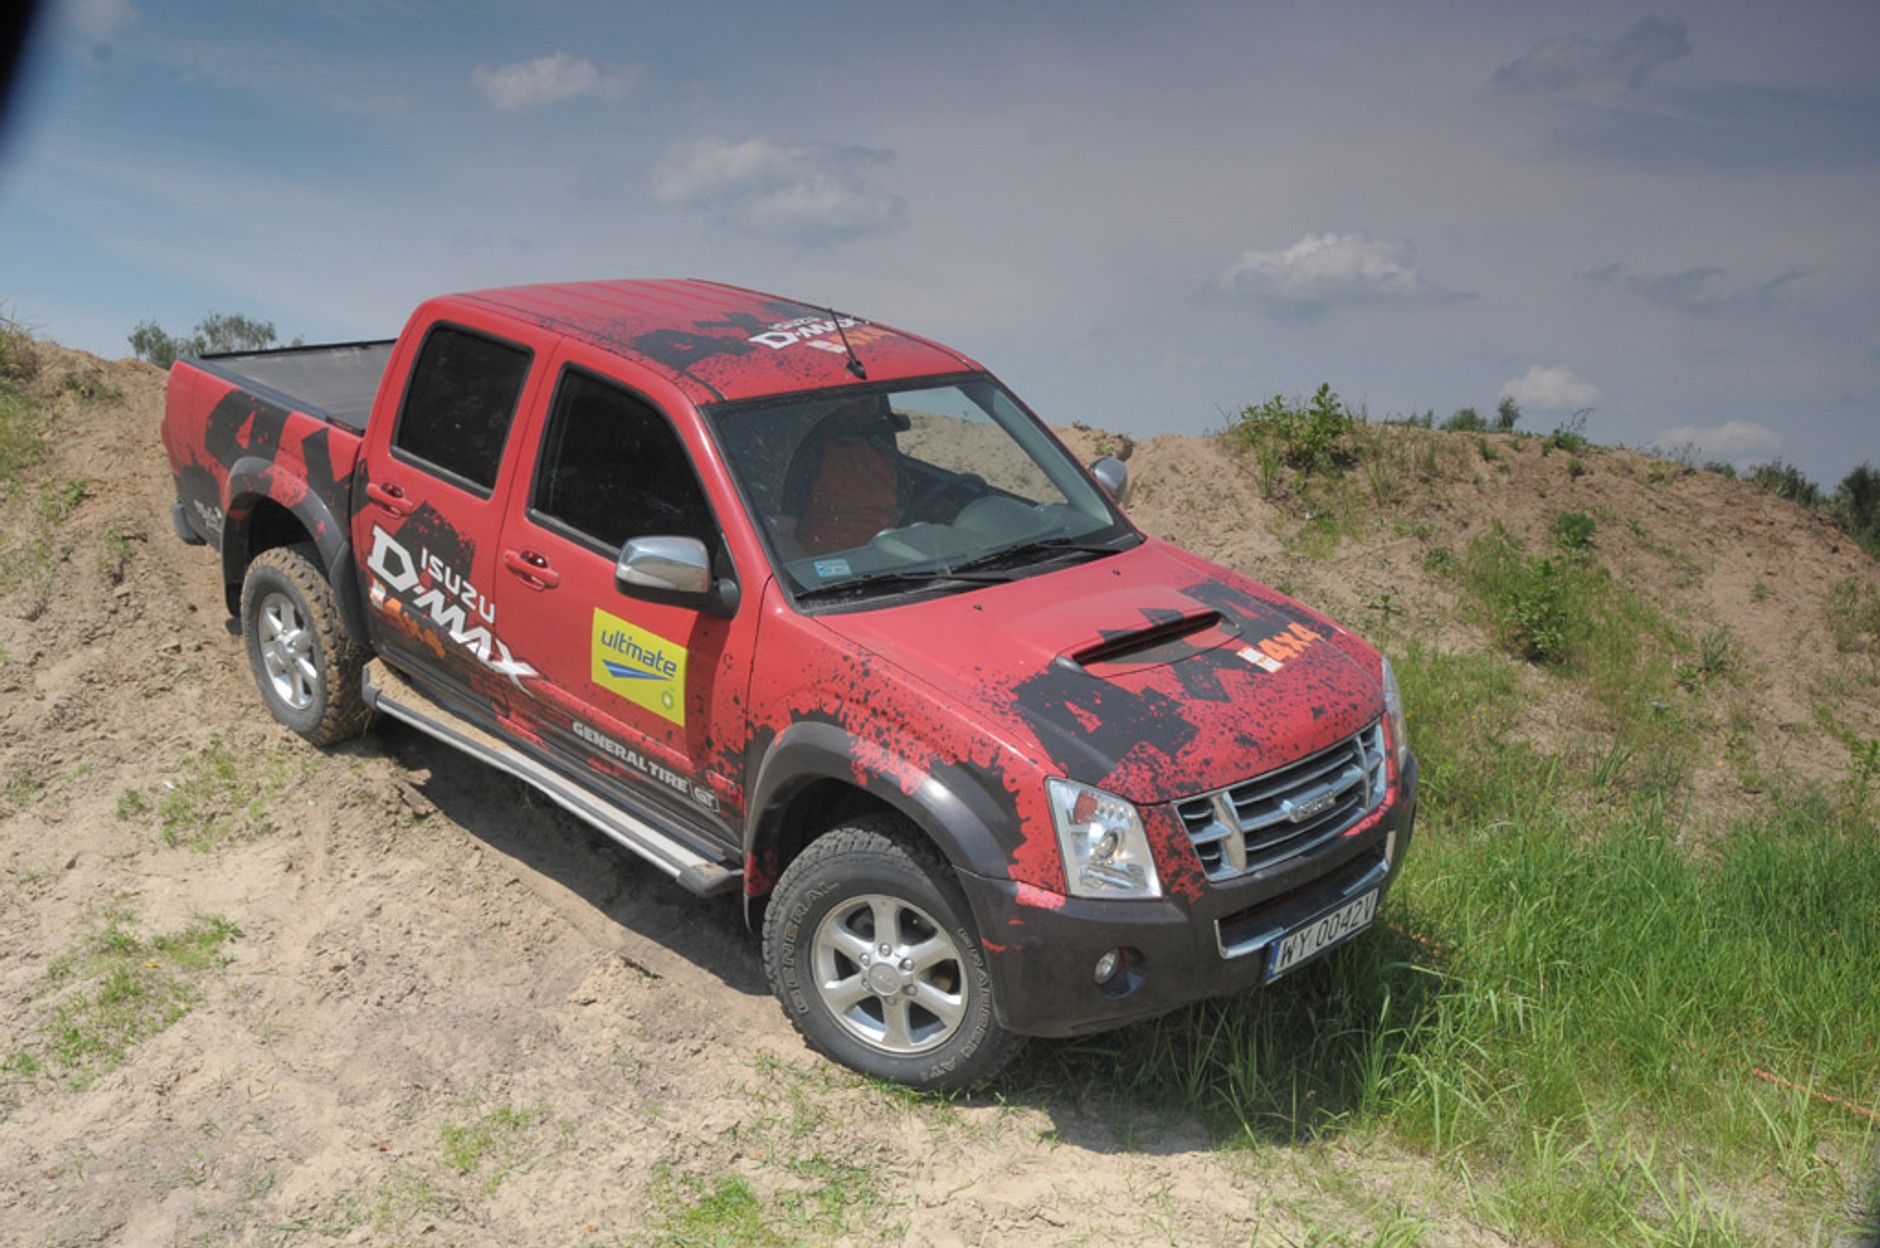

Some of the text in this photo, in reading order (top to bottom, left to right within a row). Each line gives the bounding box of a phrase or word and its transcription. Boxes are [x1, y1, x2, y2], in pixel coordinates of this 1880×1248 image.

[367, 525, 540, 698] D-MAX
[420, 546, 496, 624] ISUZU
[600, 629, 677, 678] ultimate
[572, 719, 647, 775] GENERAL
[647, 761, 689, 793] TIRE
[1279, 893, 1377, 969] WY 0042V
